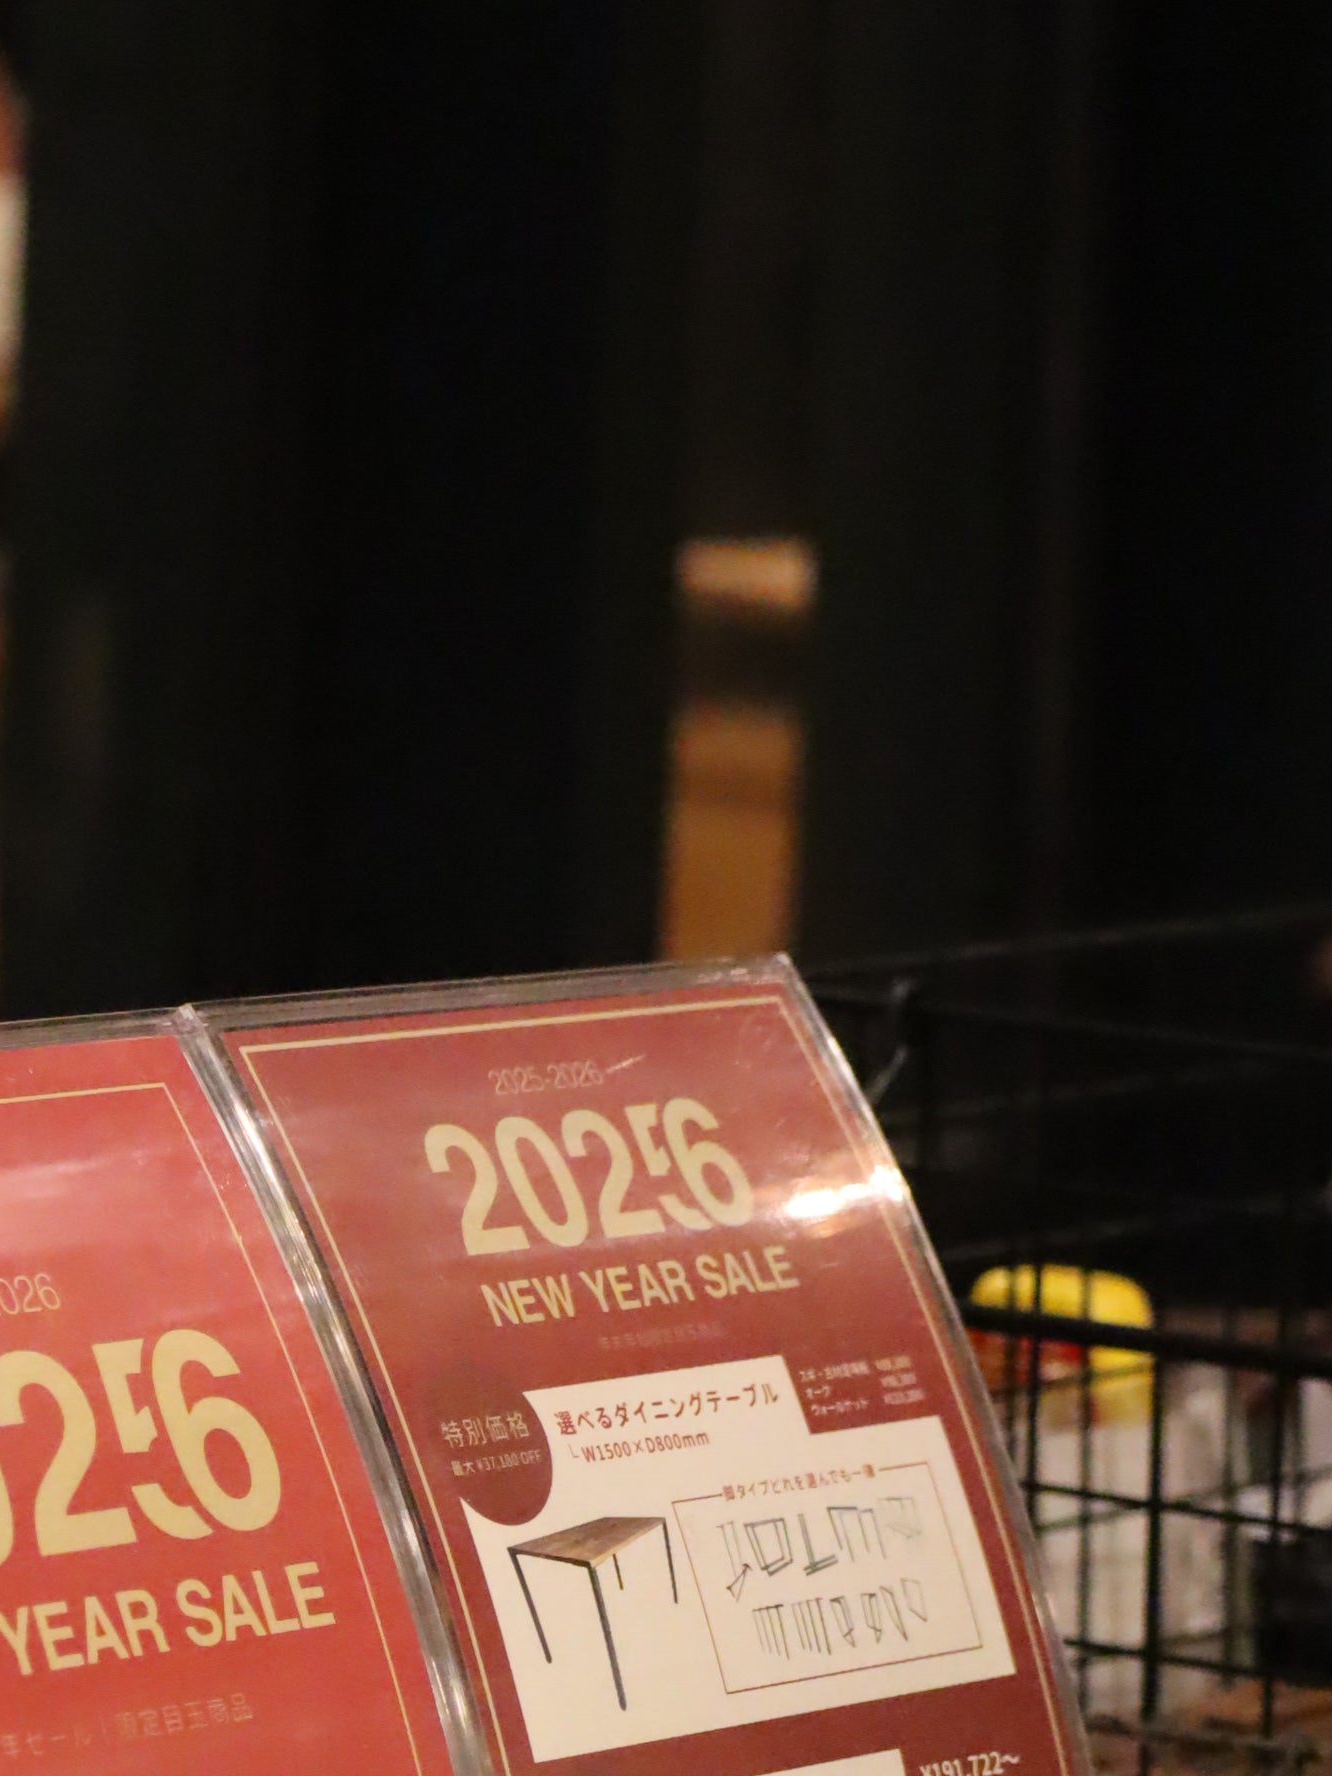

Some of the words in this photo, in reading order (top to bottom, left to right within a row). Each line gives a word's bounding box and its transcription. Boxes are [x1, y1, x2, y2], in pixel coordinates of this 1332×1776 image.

[488, 1059, 604, 1095] 2025-2026
[480, 1273, 576, 1328] NEW
[578, 1258, 695, 1314] YEAR
[695, 1245, 801, 1300] SALE
[440, 1411, 531, 1449] 特別価格
[554, 1383, 779, 1436] 選べるダイニングテーブル
[519, 1449, 542, 1465] OFF
[175, 1560, 336, 1648] SALE
